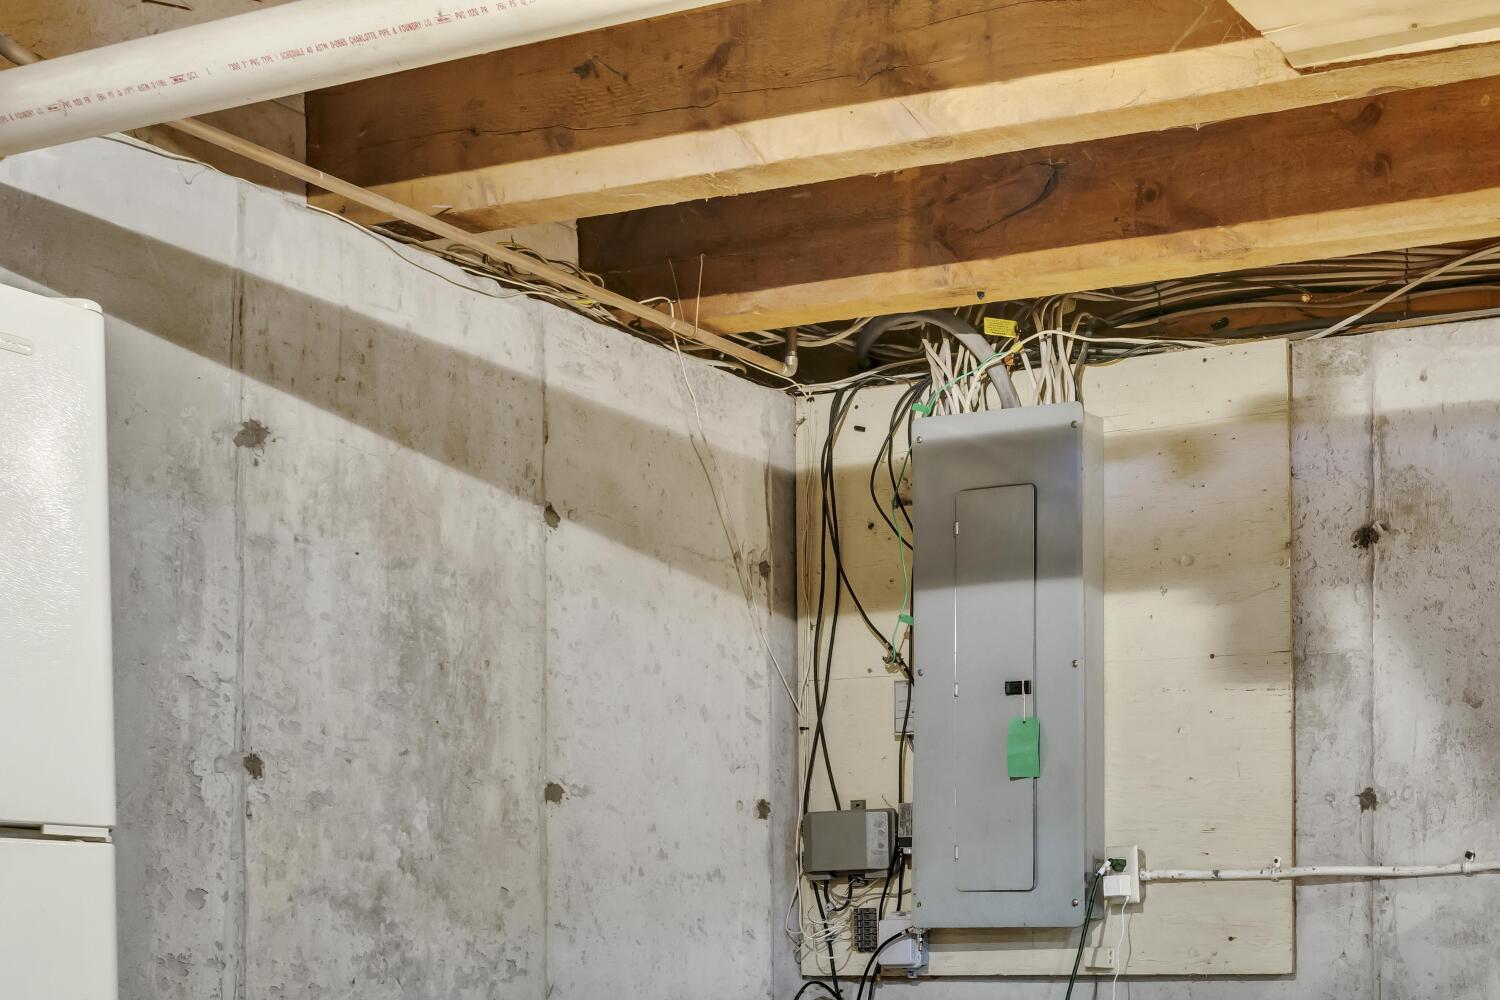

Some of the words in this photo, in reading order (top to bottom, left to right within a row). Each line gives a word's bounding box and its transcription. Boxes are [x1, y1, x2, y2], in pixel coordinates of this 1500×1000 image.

[261, 55, 274, 64] TYPE
[280, 48, 305, 60] SCHEDULE
[315, 43, 328, 52] ASTM
[349, 31, 378, 44] CHARLOTTE
[378, 27, 391, 38] PIPE
[399, 19, 422, 33] FOUNDRY
[454, 11, 466, 21] PVC
